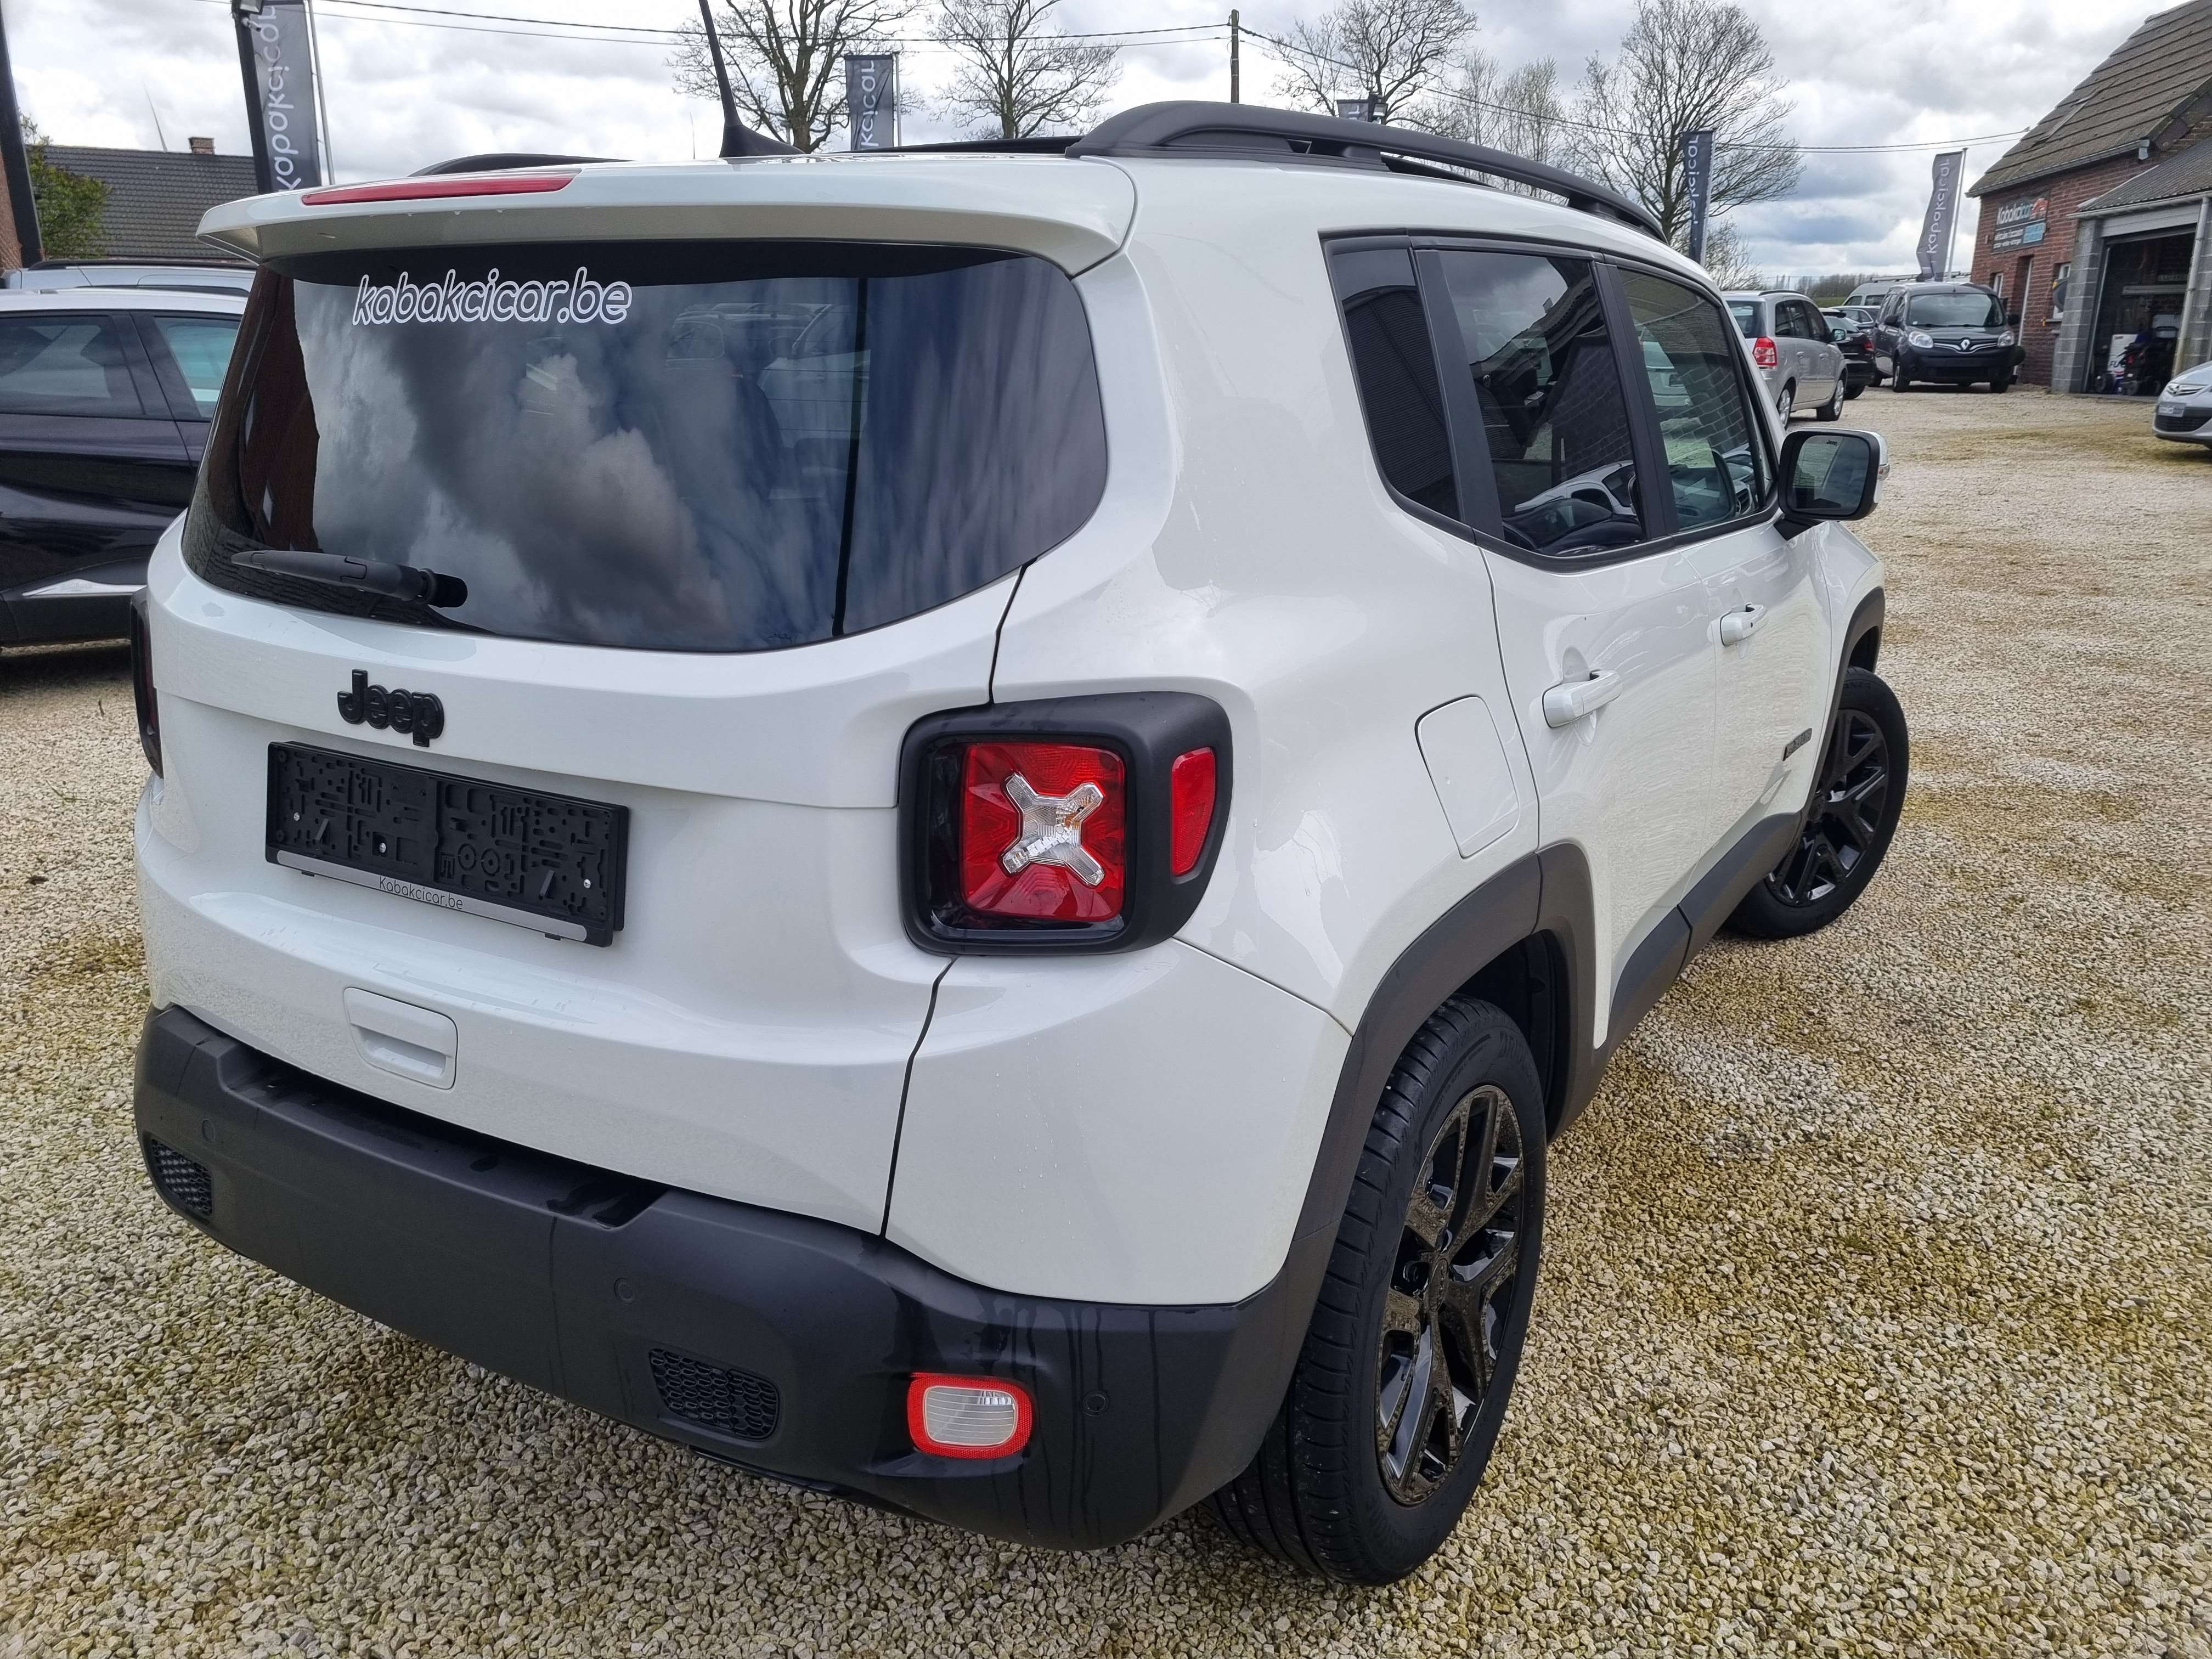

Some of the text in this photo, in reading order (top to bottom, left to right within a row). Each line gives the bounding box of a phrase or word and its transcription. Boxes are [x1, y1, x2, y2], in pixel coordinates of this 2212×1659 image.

[353, 267, 633, 325] kabakcicar.be
[337, 669, 444, 747] Jeep
[379, 877, 463, 910] Kabakcicar.be
